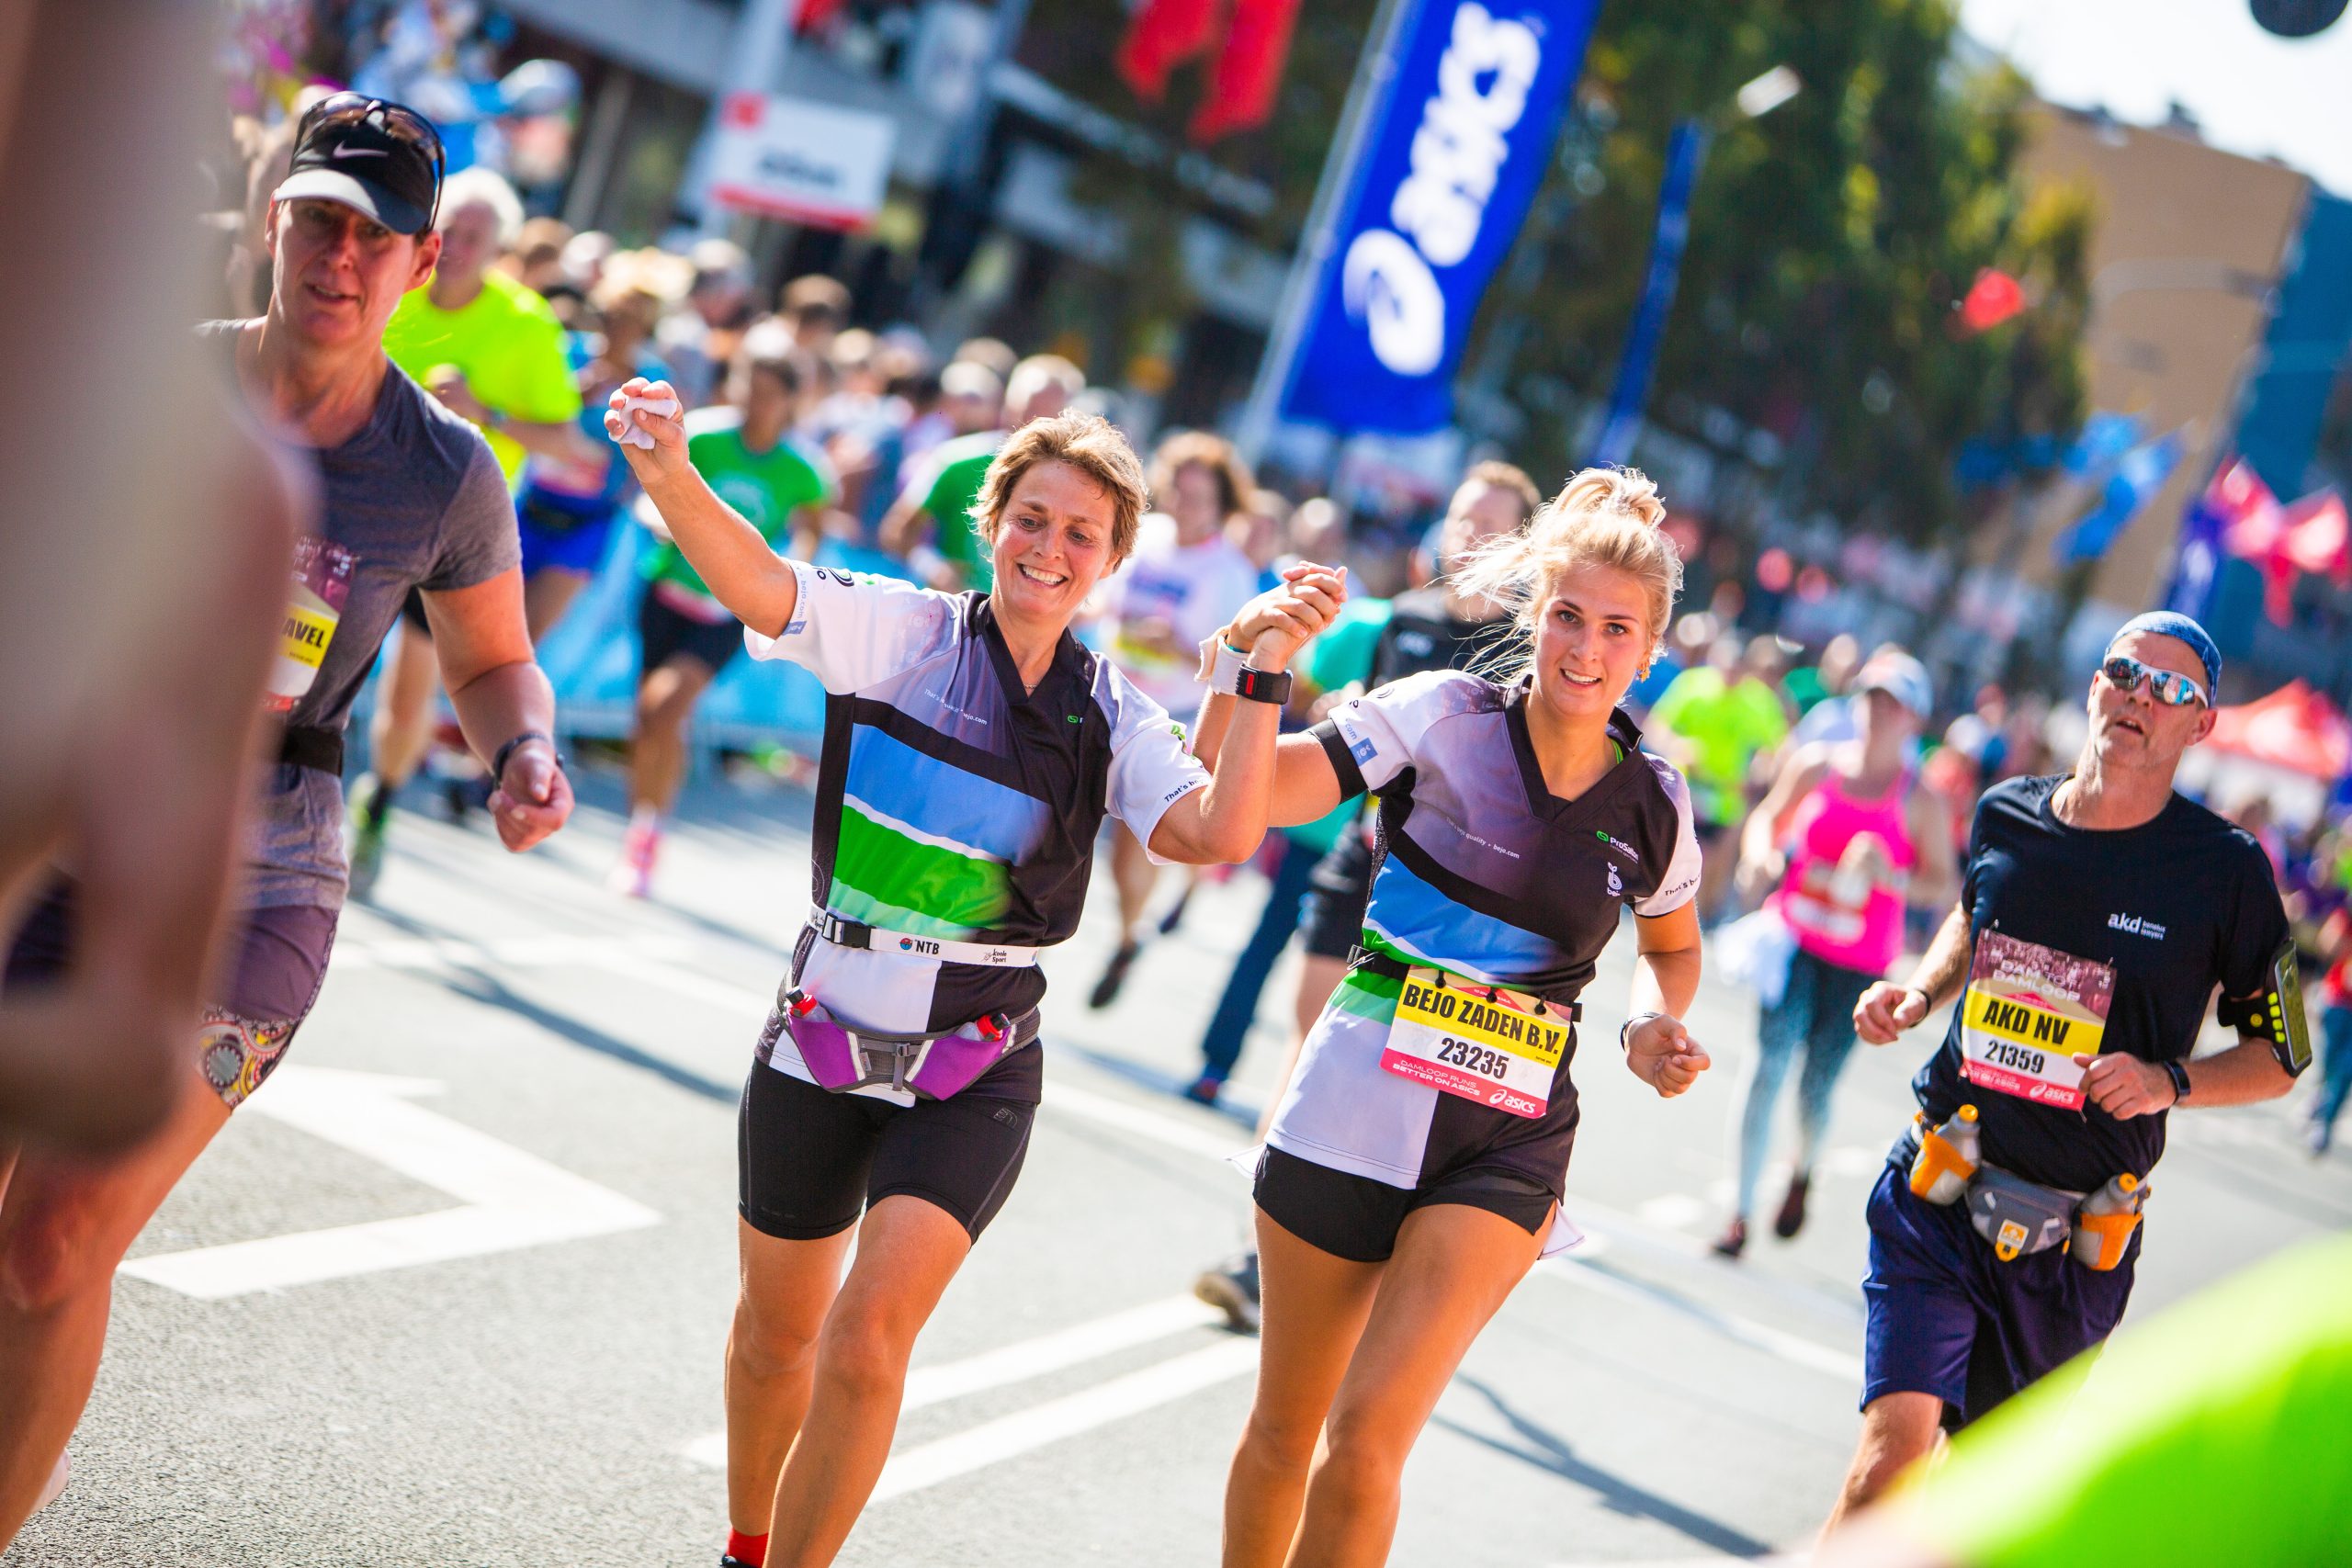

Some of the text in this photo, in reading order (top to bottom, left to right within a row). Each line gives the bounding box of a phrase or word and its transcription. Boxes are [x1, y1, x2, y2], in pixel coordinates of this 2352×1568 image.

[281, 616, 326, 649] AVEL
[1164, 784, 1188, 804] That's
[1465, 832, 1487, 846] quality
[1493, 843, 1520, 860] bejo.com
[2108, 911, 2142, 934] akd
[915, 940, 940, 955] NTB
[2000, 959, 2041, 978] DAM
[1993, 969, 2080, 1001] DAMLOOP
[1402, 984, 1560, 1055] BEJO ZADEN B.V.
[1982, 998, 2030, 1034] AKD
[2033, 1013, 2071, 1045] NV
[1437, 1037, 1510, 1080] 23235
[1984, 1039, 2045, 1075] 21359
[1393, 1063, 1481, 1096] BETTER ON ASICS
[1400, 1059, 1477, 1089] DAMLOOP RUNS
[1504, 1093, 1536, 1114] asics
[2043, 1086, 2076, 1105] asics
